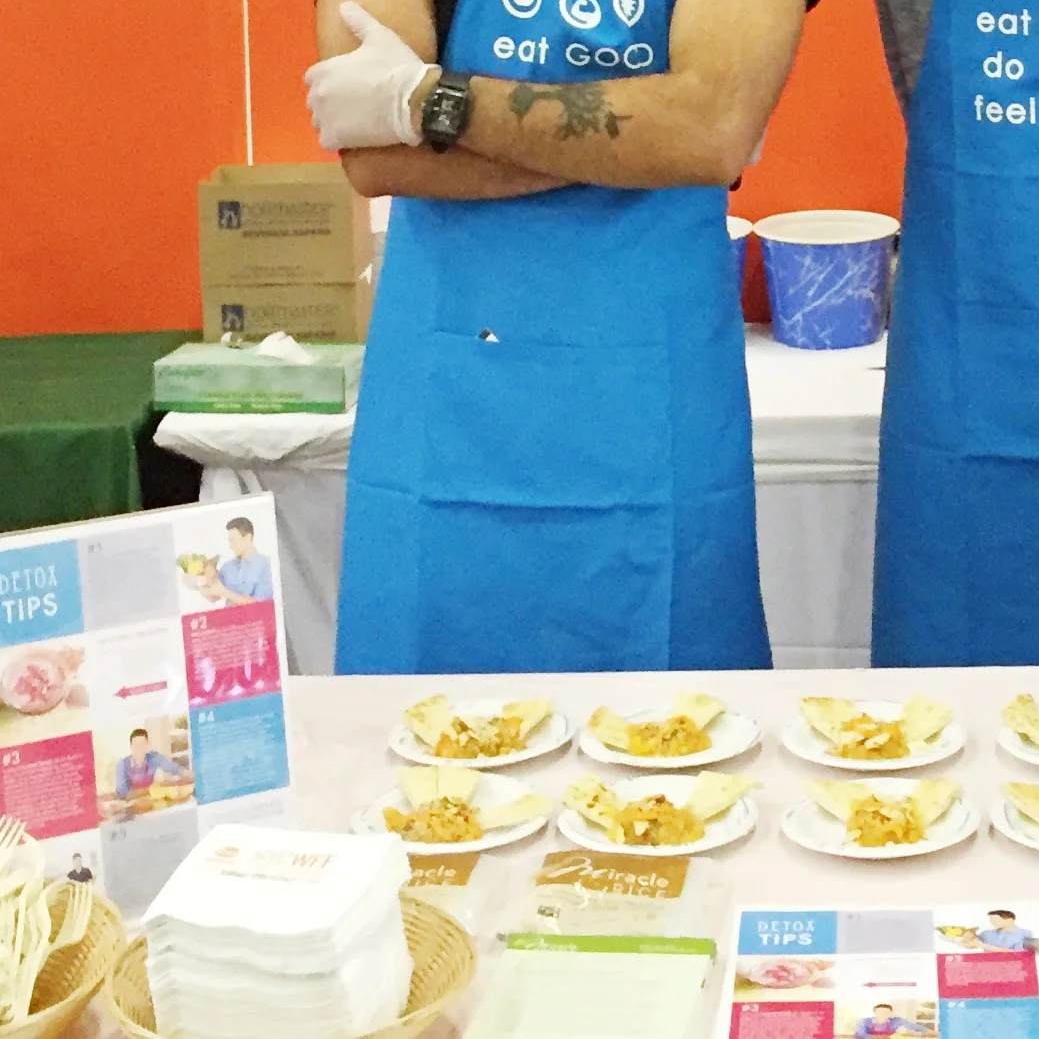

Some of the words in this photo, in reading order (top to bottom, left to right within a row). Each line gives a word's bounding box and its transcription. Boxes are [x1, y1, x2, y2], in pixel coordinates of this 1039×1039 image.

[976, 9, 1033, 36] eat
[493, 36, 550, 65] eat
[982, 50, 1025, 80] do
[973, 94, 1037, 124] feel
[0, 564, 58, 596] DETOX
[1, 592, 58, 625] TIPS
[757, 920, 816, 933] DETOX
[758, 932, 813, 946] TIPS
